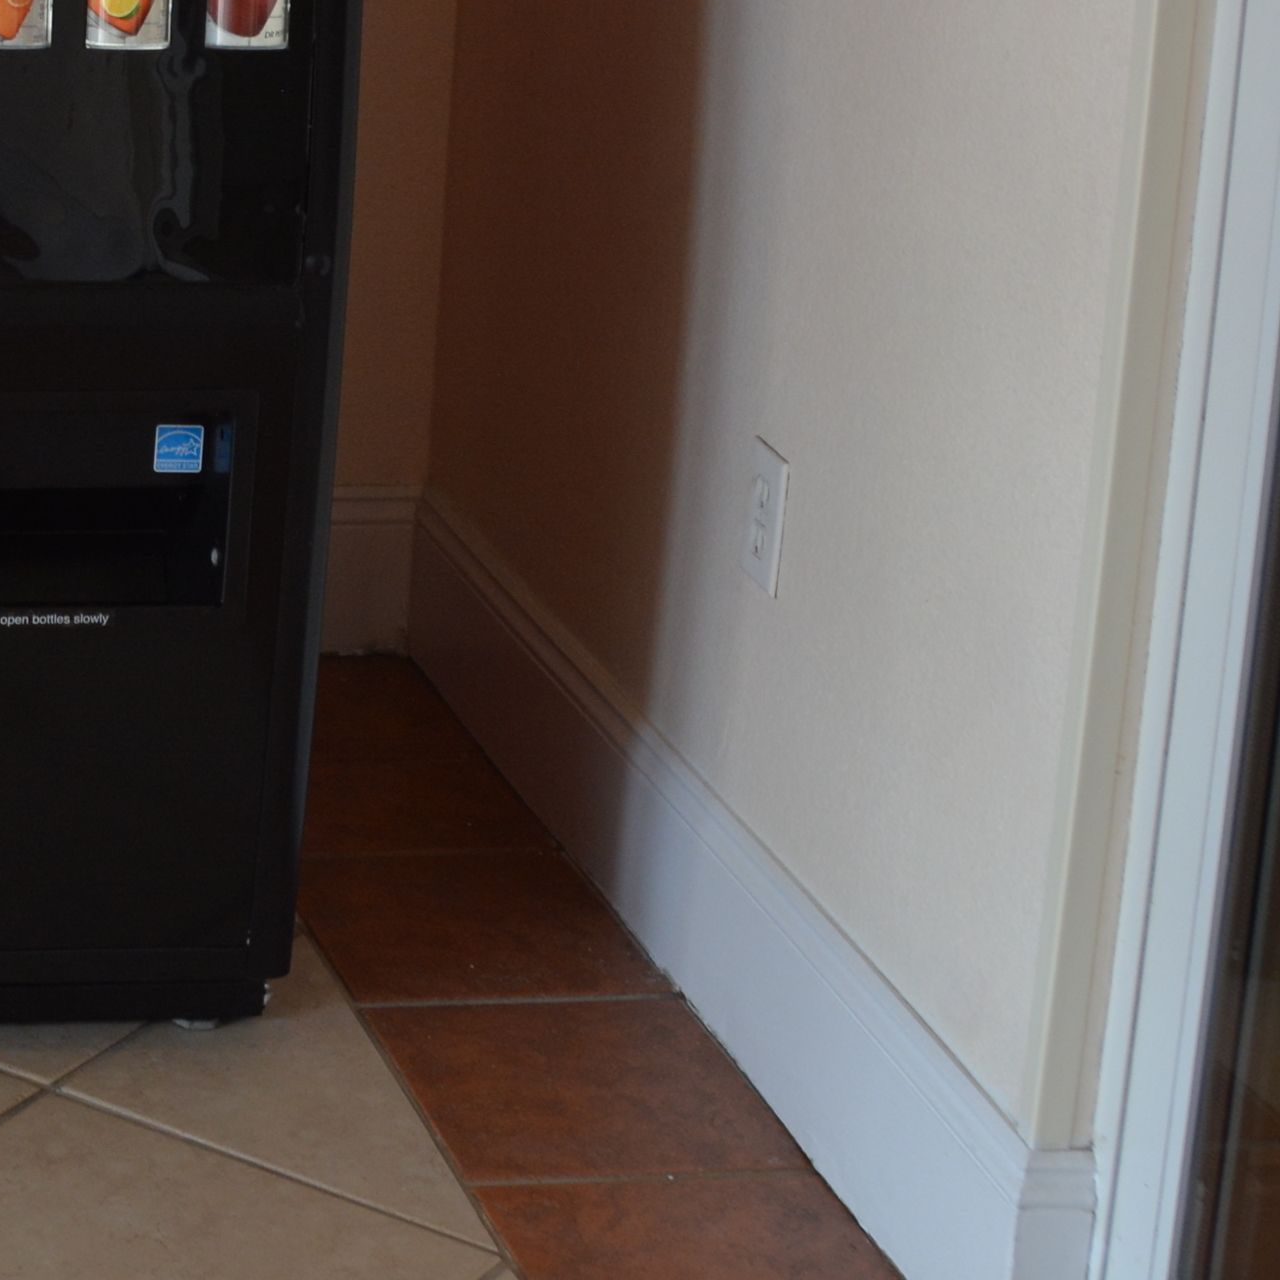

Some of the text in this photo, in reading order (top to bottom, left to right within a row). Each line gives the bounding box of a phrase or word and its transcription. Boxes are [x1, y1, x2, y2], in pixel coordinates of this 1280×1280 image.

[0, 615, 30, 627] open
[32, 612, 71, 625] bottles
[73, 612, 110, 627] slowly
